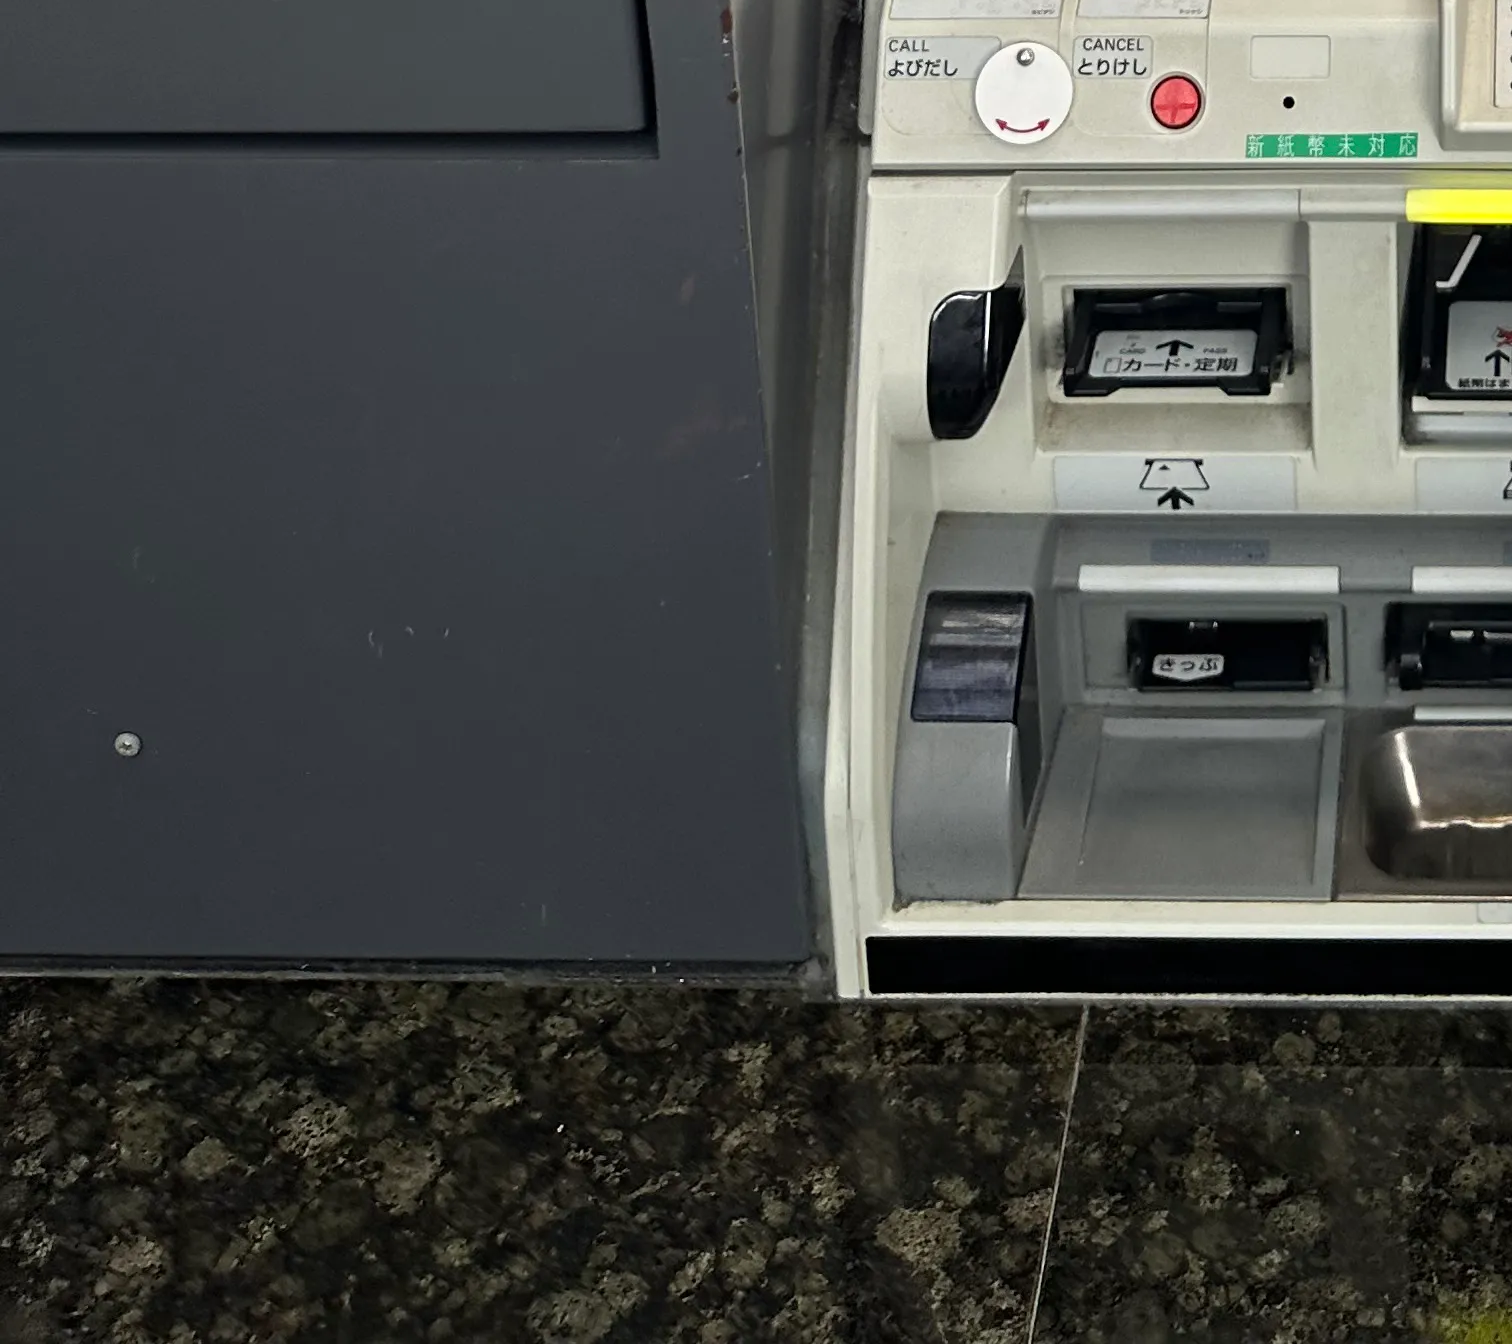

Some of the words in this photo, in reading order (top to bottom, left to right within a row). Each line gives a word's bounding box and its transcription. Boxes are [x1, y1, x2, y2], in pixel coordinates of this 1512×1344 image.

[889, 39, 931, 53] CALL
[1082, 38, 1145, 52] CANCEL
[888, 59, 959, 77] よびだし
[1077, 58, 1147, 76] とりけし
[1122, 357, 1238, 372] カード・定期
